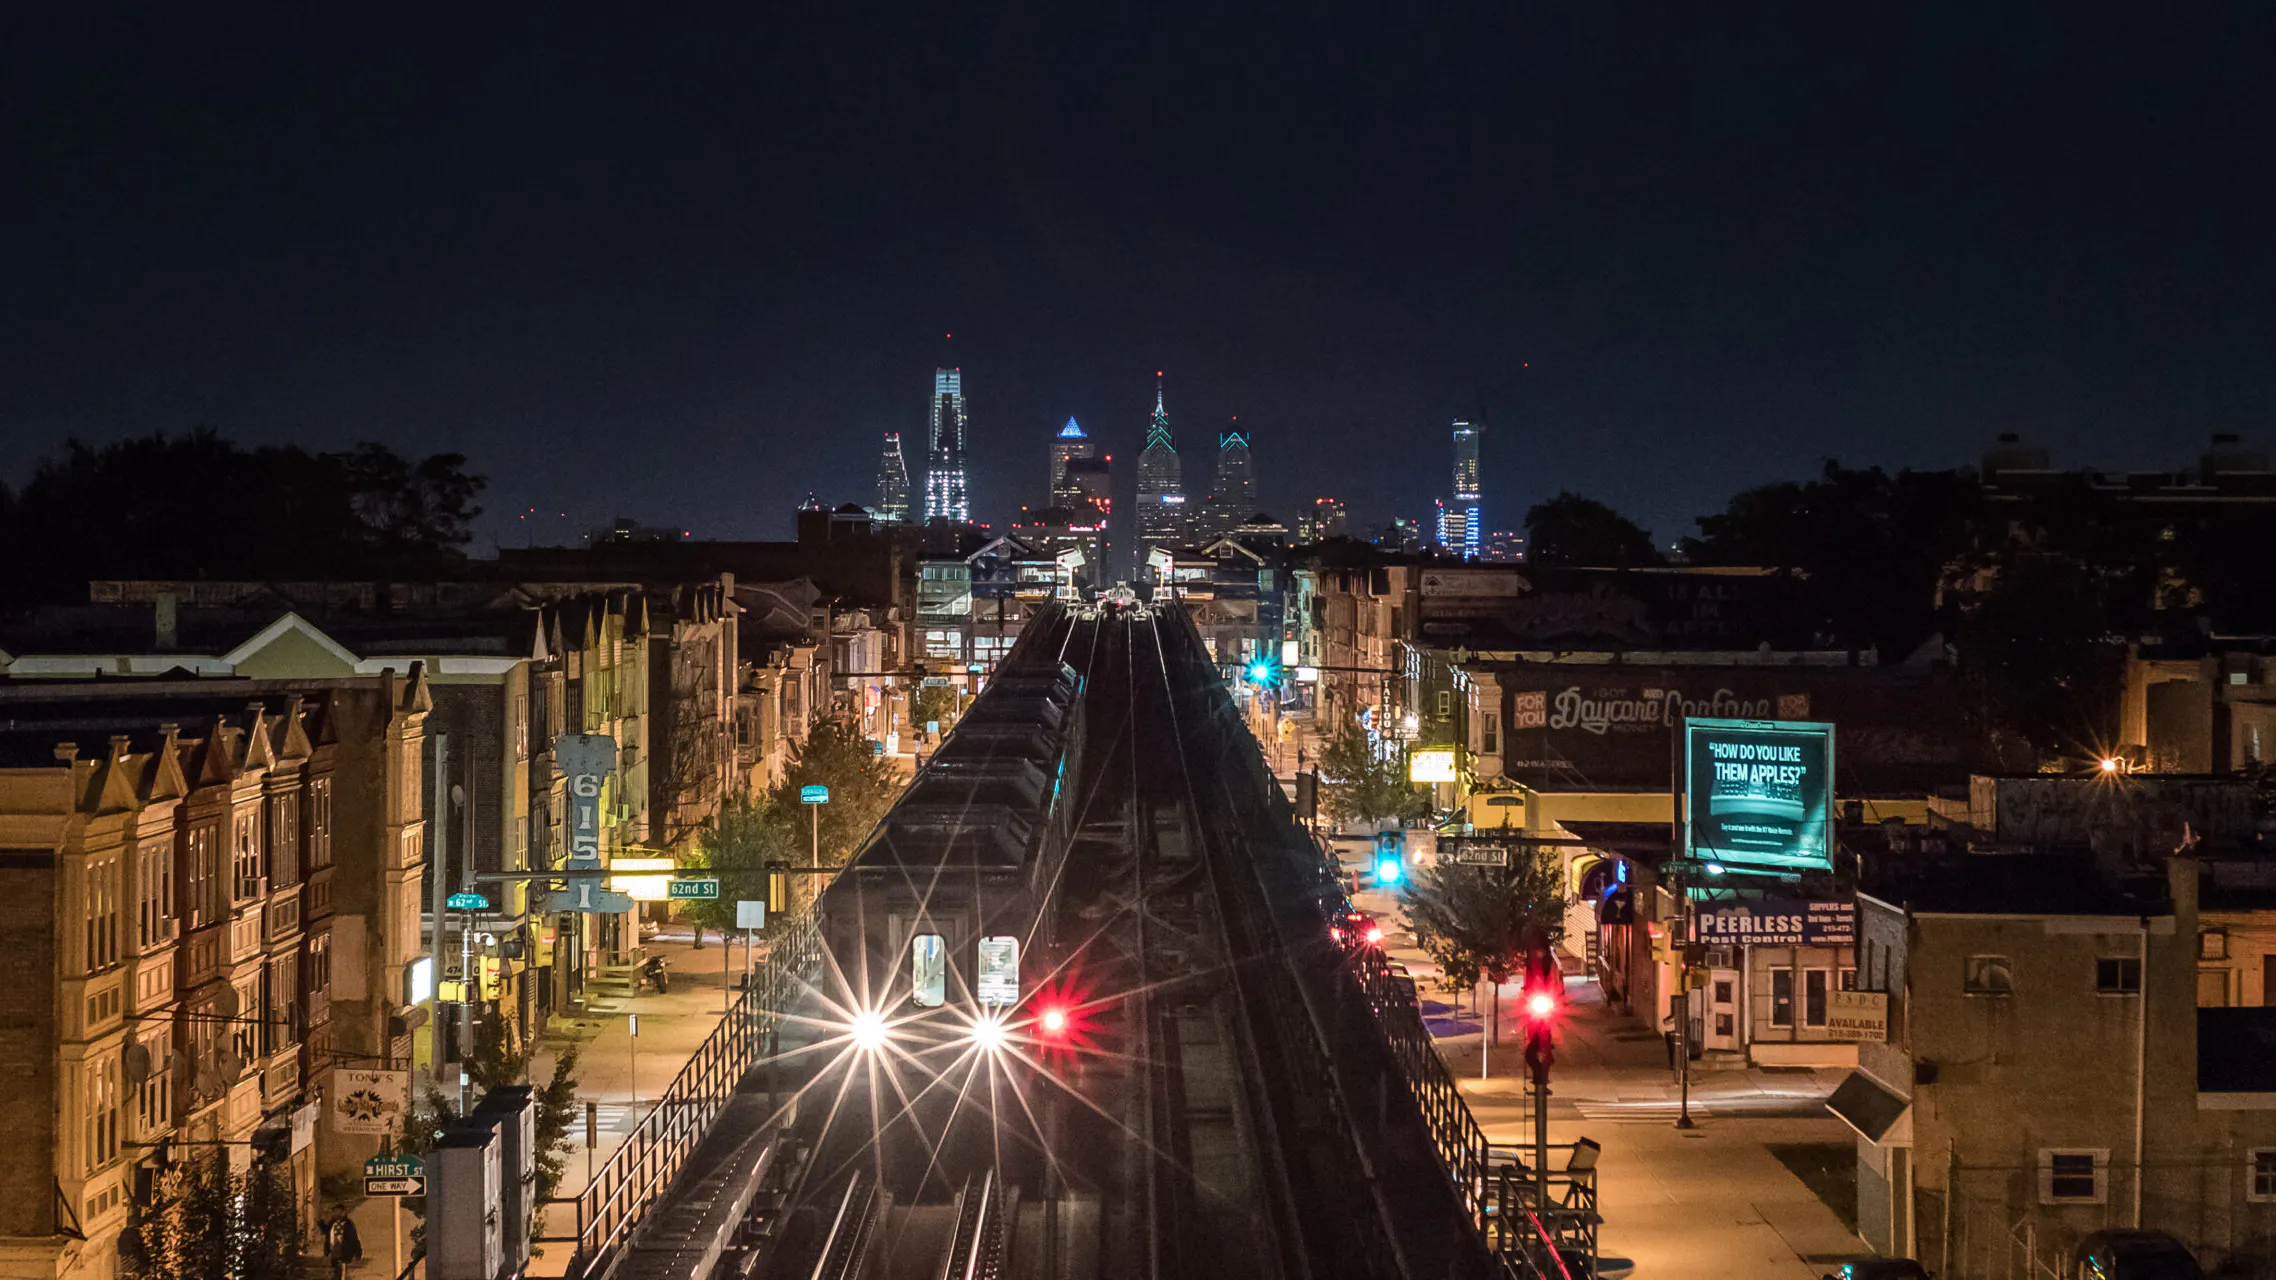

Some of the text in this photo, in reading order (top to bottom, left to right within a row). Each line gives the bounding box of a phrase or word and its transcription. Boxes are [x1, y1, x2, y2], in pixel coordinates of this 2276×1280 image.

[1383, 680, 1391, 728] TATTOO
[1518, 696, 1545, 711] FOR
[1550, 686, 1660, 735] Daycare
[1516, 711, 1546, 726] YOU
[1740, 745, 1755, 760] DO
[1756, 746, 1777, 761] YOU
[1779, 747, 1801, 762] LIKE
[1714, 762, 1748, 781] THEM
[574, 773, 598, 909] 6151
[671, 882, 714, 894] 62nd St
[1700, 913, 1804, 934] PEERLESS
[1700, 933, 1804, 944] Pest Control
[1829, 1018, 1885, 1030] AVAILABLE
[376, 1164, 410, 1176] HIRST
[413, 1166, 424, 1175] ST
[371, 1182, 408, 1191] ONE WAY
